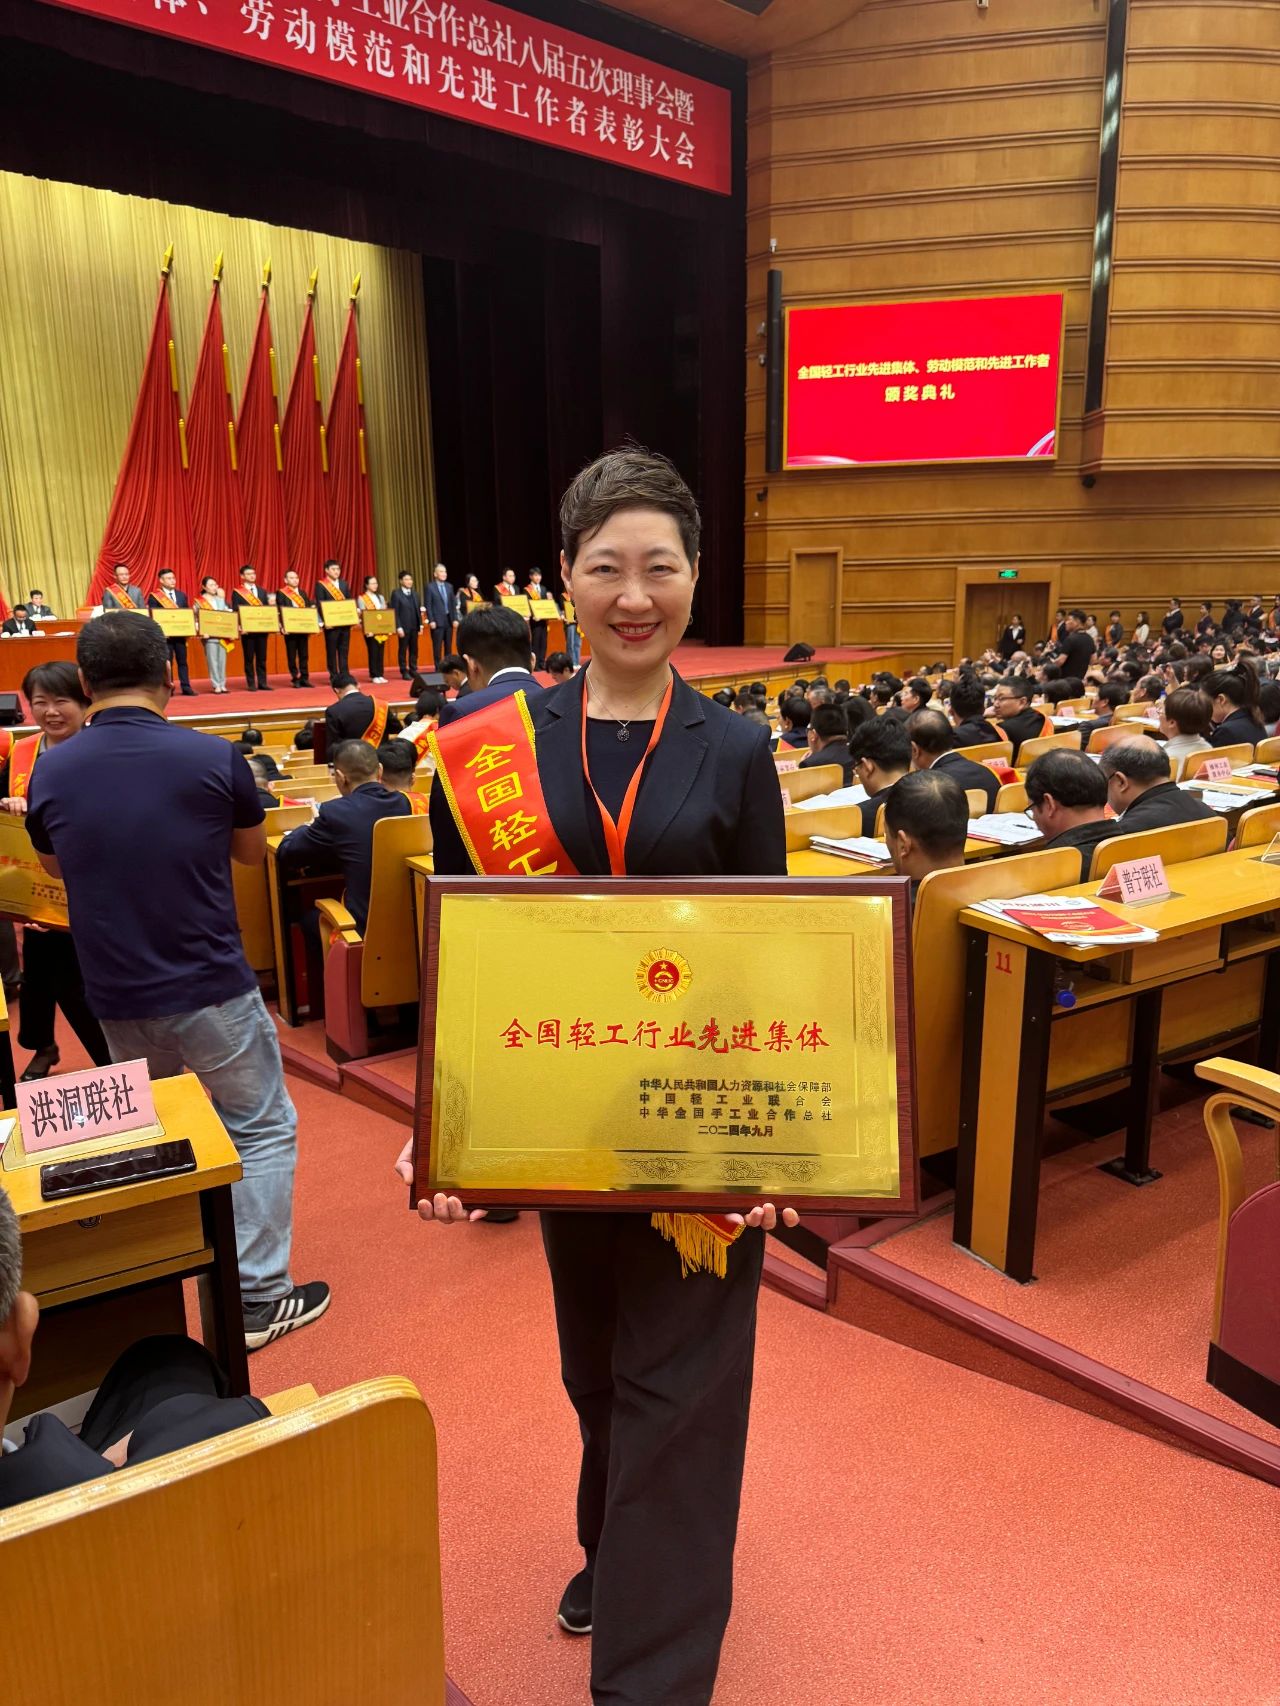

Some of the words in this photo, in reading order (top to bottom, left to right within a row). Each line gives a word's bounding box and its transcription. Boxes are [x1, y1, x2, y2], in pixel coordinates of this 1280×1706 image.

[331, 0, 695, 126] 工业合作总社八届五次理事会暨
[154, 0, 696, 169] 、劳动模范和先进工作者表彰大会
[884, 384, 956, 403] 颁奖典礼
[464, 743, 558, 876] 全国轻工
[1122, 864, 1163, 895] 普宁联社
[995, 951, 1013, 975] 11
[499, 1017, 830, 1054] 全国轻工行业先进集体
[639, 1079, 832, 1093] 中华人民共和国人力资源和社会保障部
[29, 1073, 139, 1138] 洪洞联社
